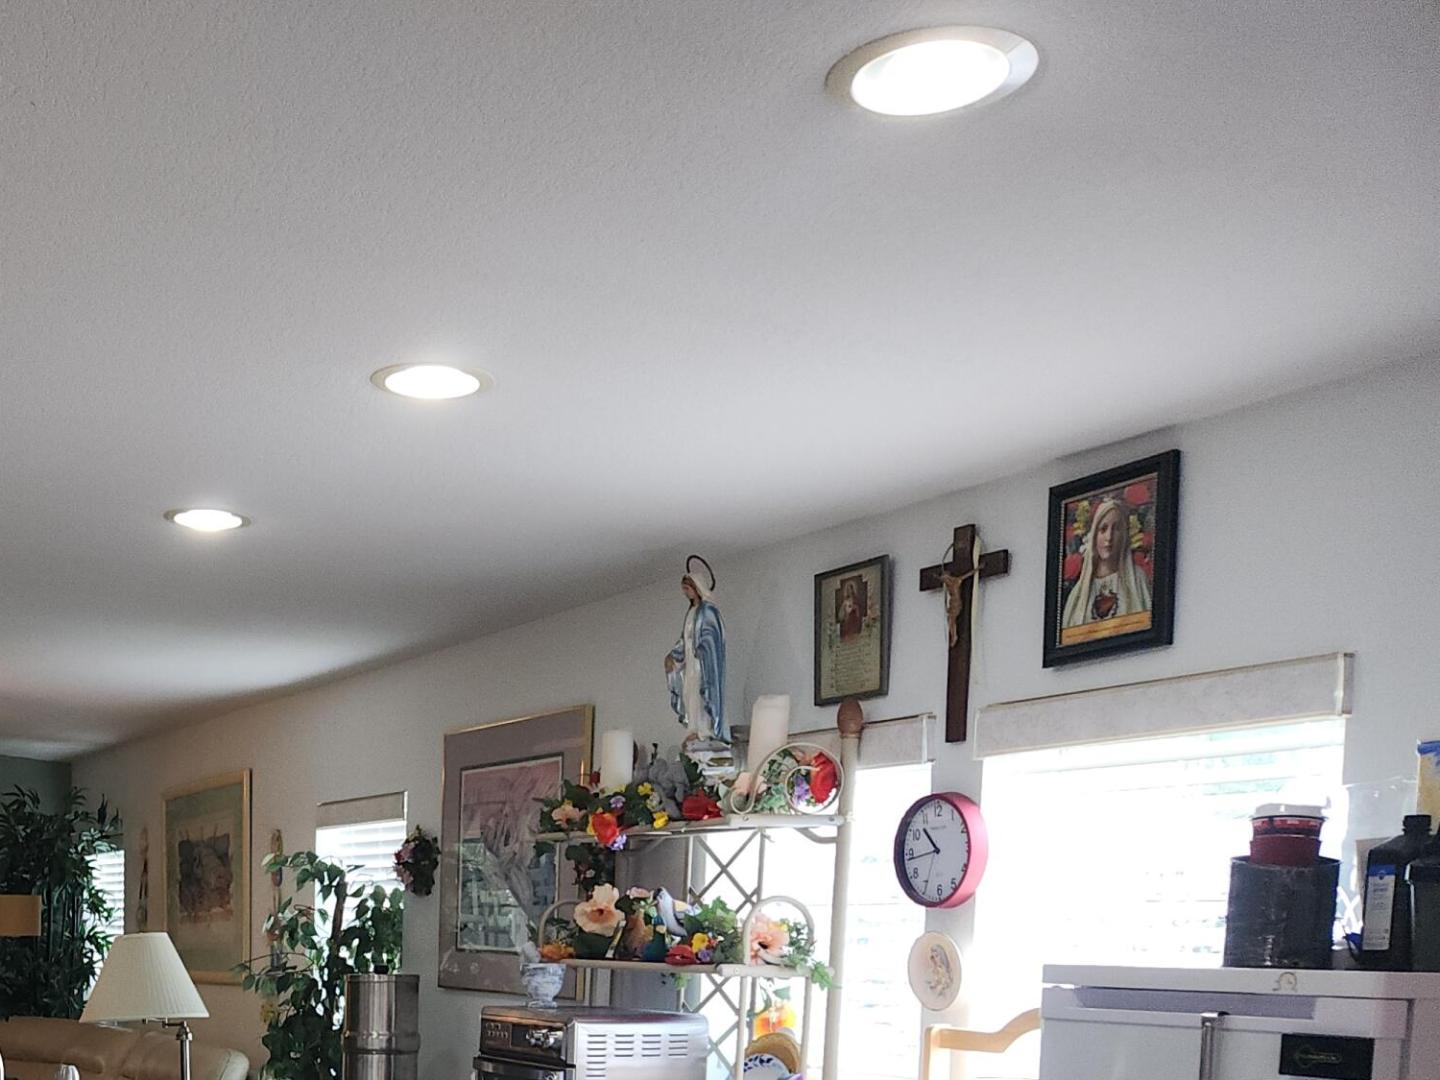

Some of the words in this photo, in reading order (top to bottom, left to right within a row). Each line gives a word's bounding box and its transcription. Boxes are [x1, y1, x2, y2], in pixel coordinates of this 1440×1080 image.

[934, 804, 943, 817] 12
[922, 813, 928, 825] 11
[912, 829, 921, 840] 10
[912, 867, 919, 879] 8
[936, 884, 943, 896] 6
[950, 878, 957, 890] 5
